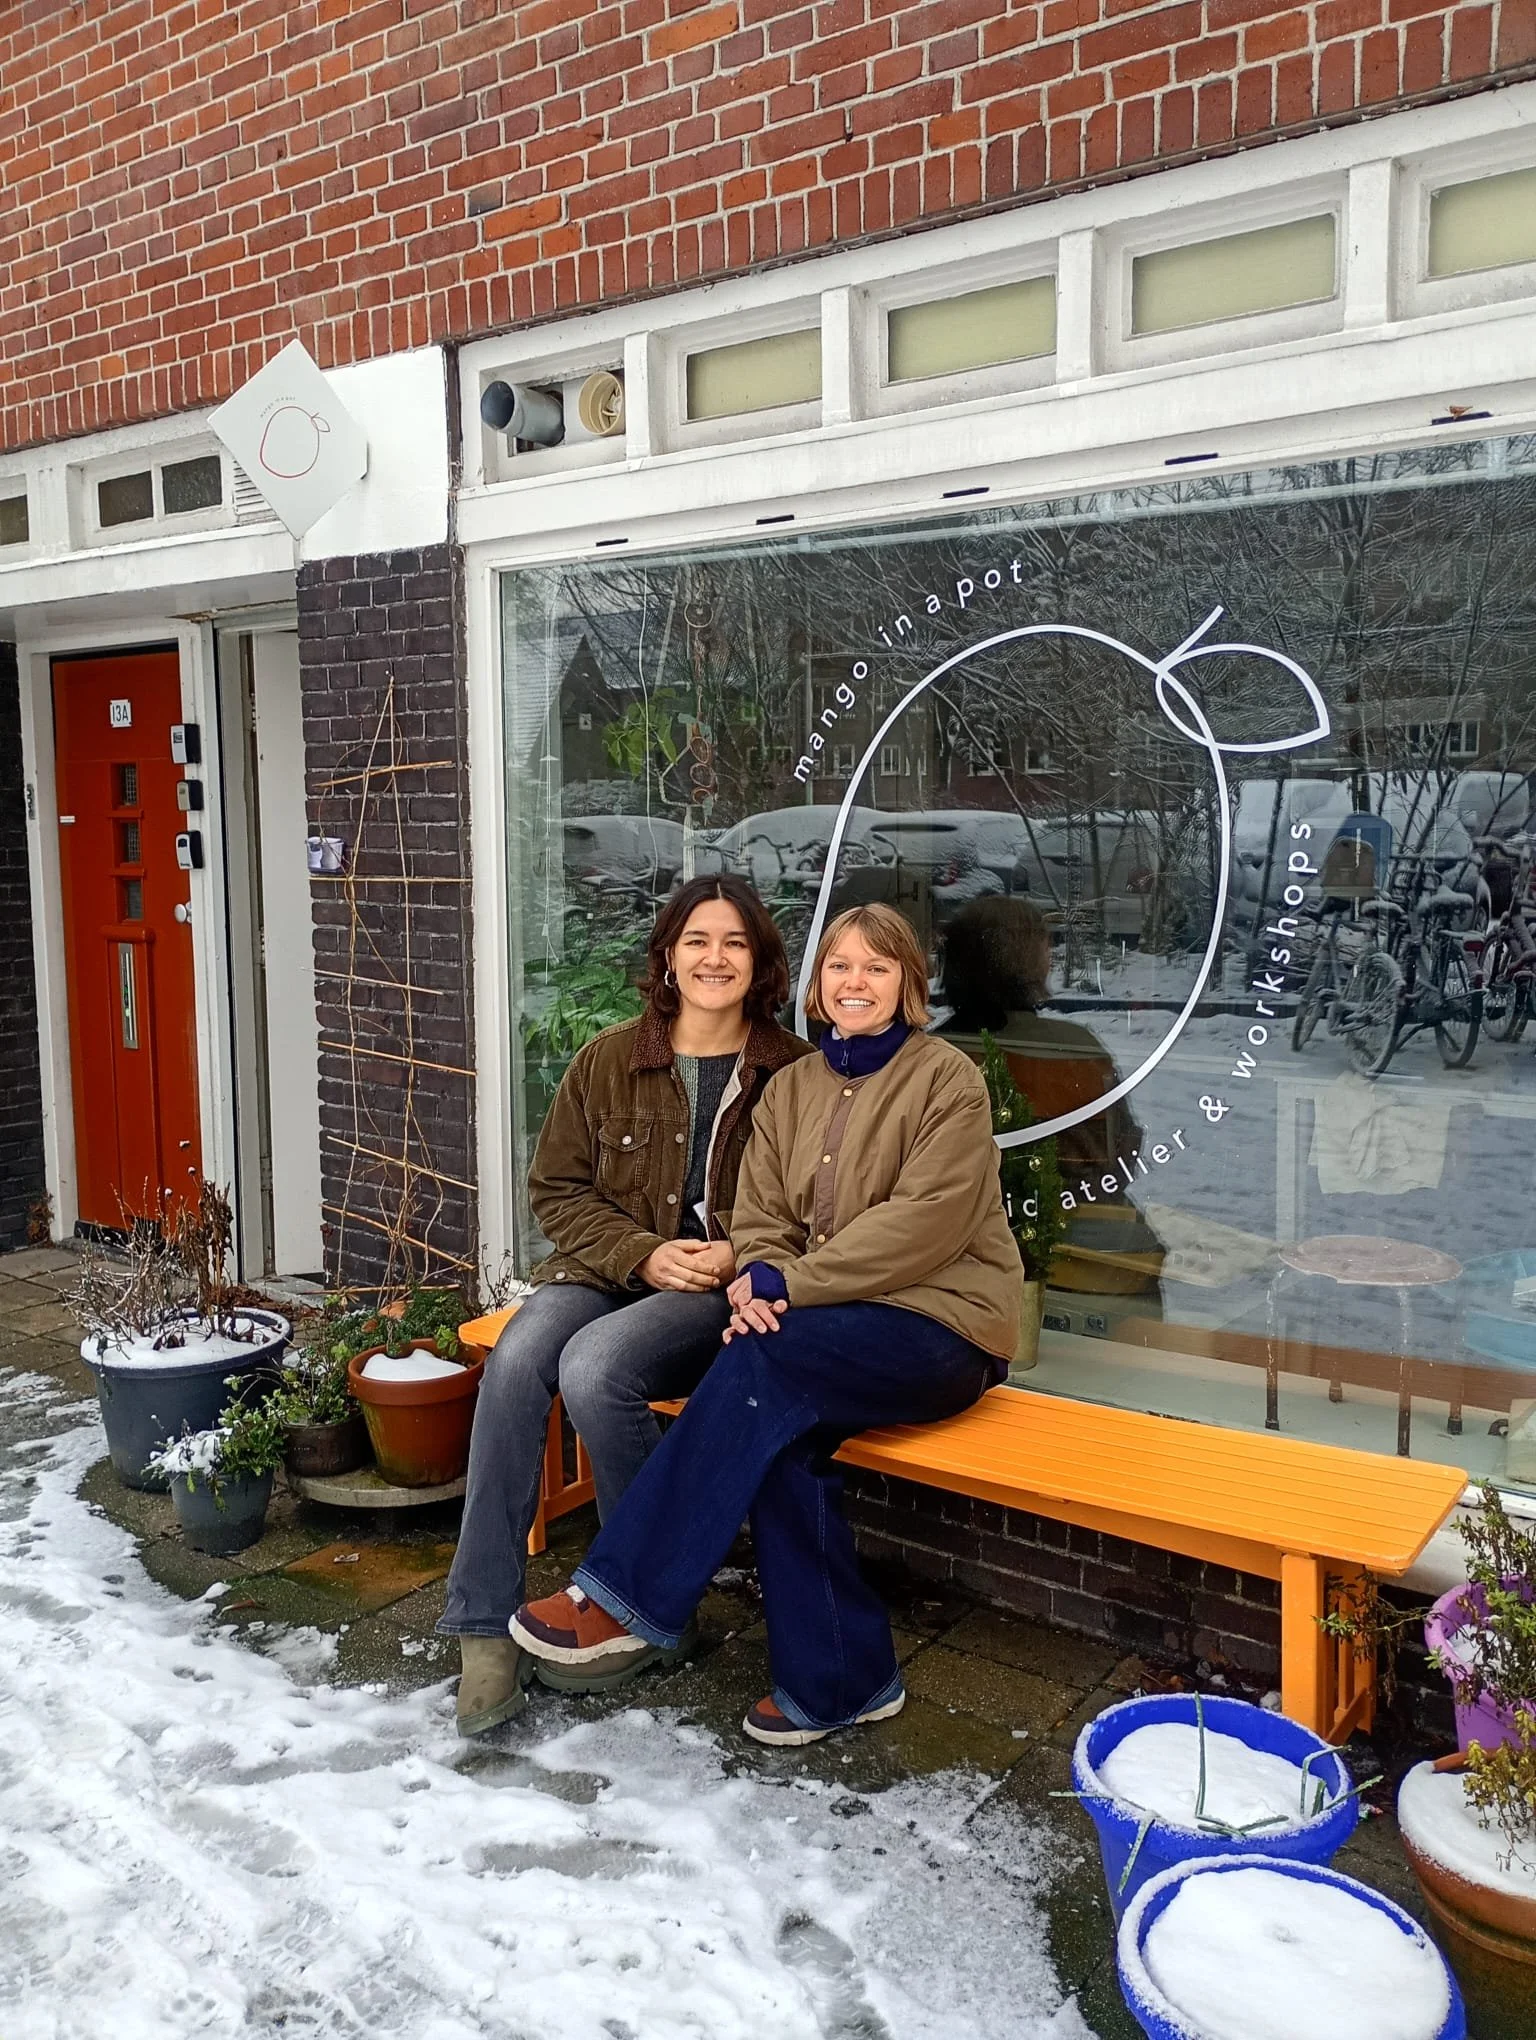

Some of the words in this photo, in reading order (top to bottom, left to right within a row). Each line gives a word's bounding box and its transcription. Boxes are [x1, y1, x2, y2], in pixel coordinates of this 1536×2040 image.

[112, 704, 129, 721] 13A
[793, 661, 868, 783] mango
[878, 615, 912, 647] in
[925, 594, 941, 614] a
[956, 559, 1022, 608] pot
[1059, 1128, 1186, 1210] atelier
[1198, 1095, 1228, 1123] &
[1231, 823, 1318, 1079] workshops
